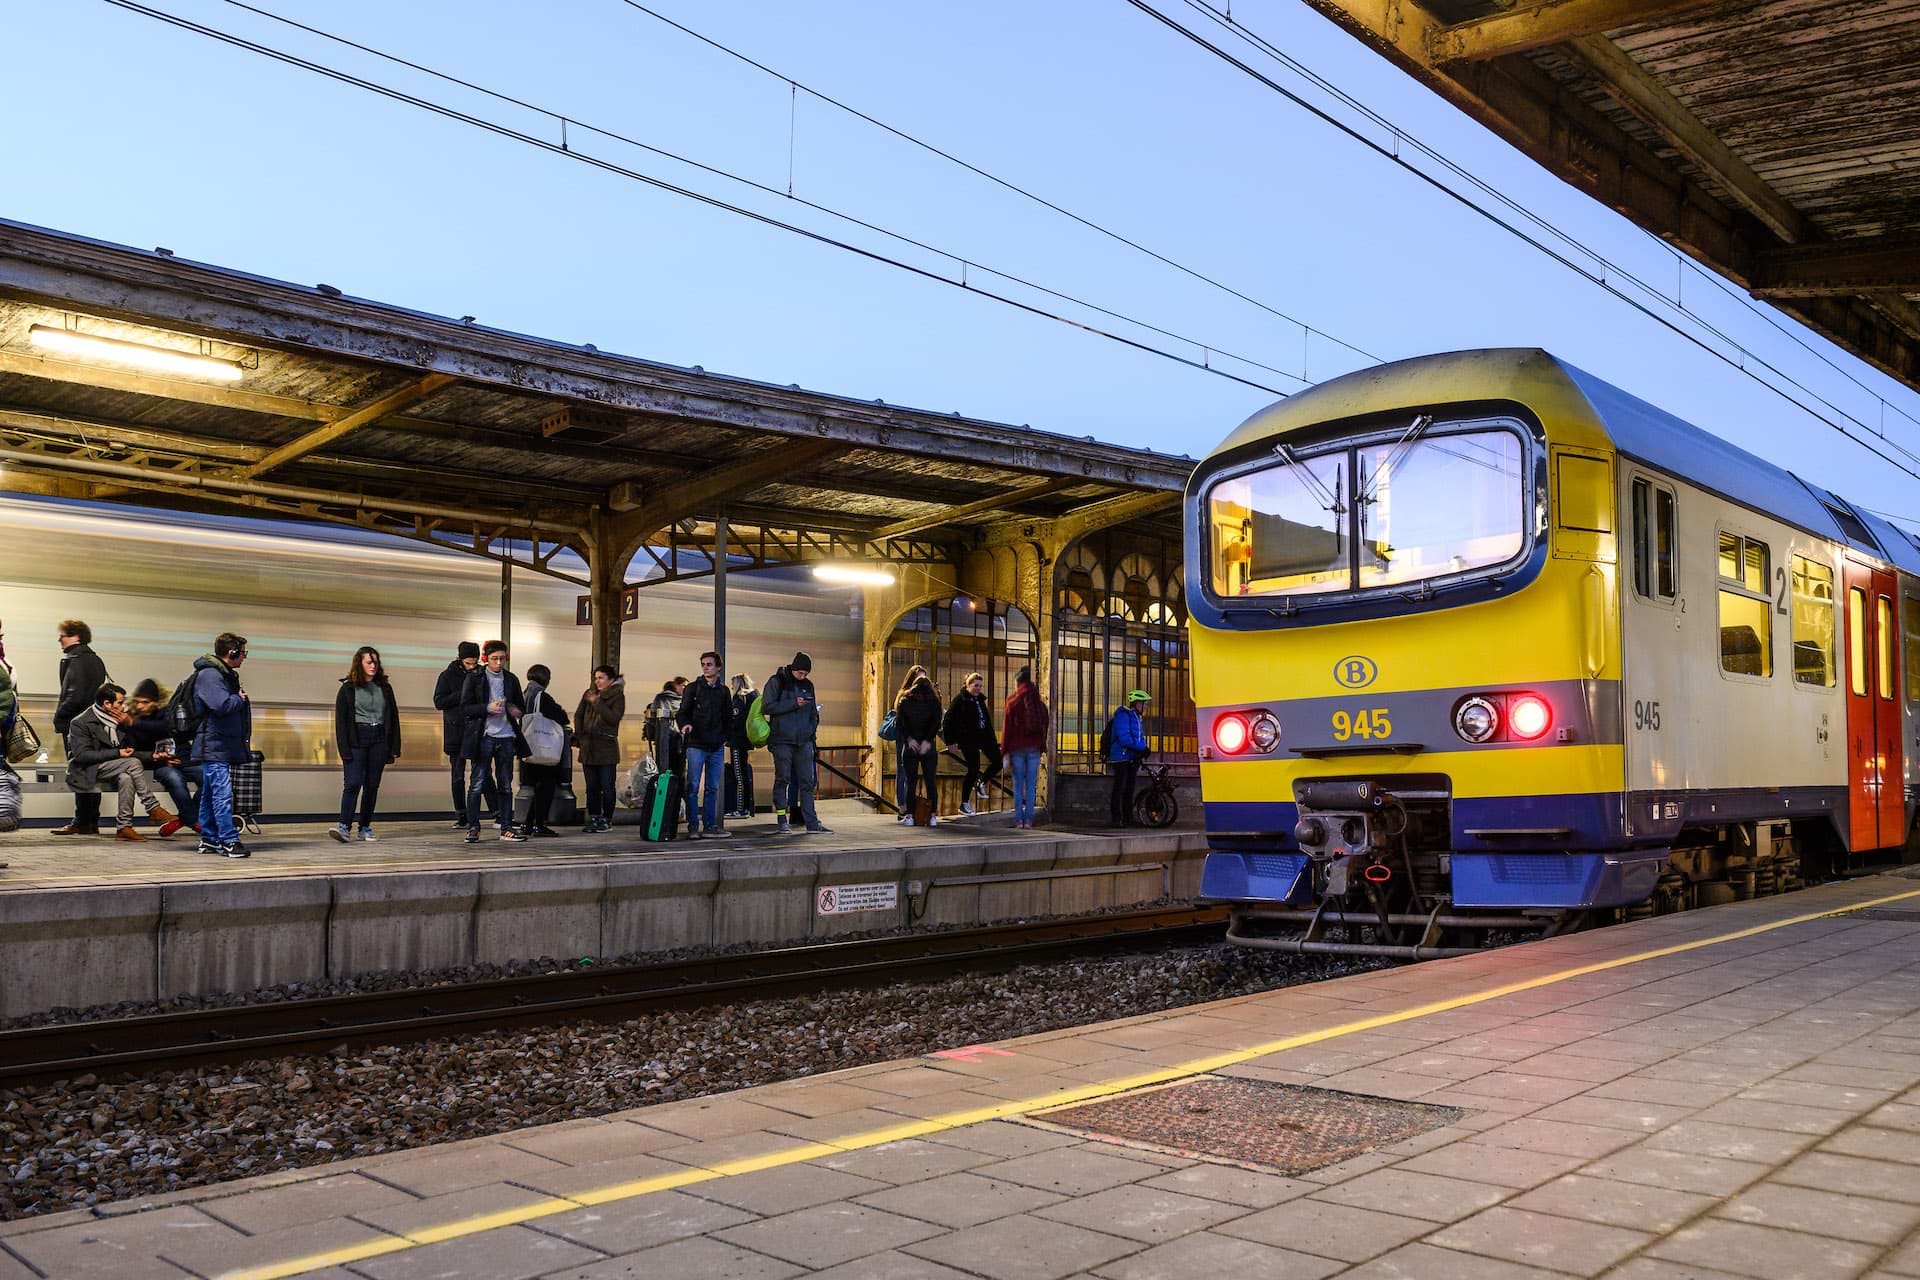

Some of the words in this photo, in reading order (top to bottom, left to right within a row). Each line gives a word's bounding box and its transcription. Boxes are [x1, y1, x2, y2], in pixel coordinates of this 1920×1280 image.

[1776, 566, 1788, 616] 2
[584, 600, 590, 619] 1
[626, 595, 633, 615] 2
[1681, 598, 1686, 613] 2
[1345, 661, 1366, 683] B
[1331, 707, 1392, 742] 945
[1634, 699, 1661, 731] 945
